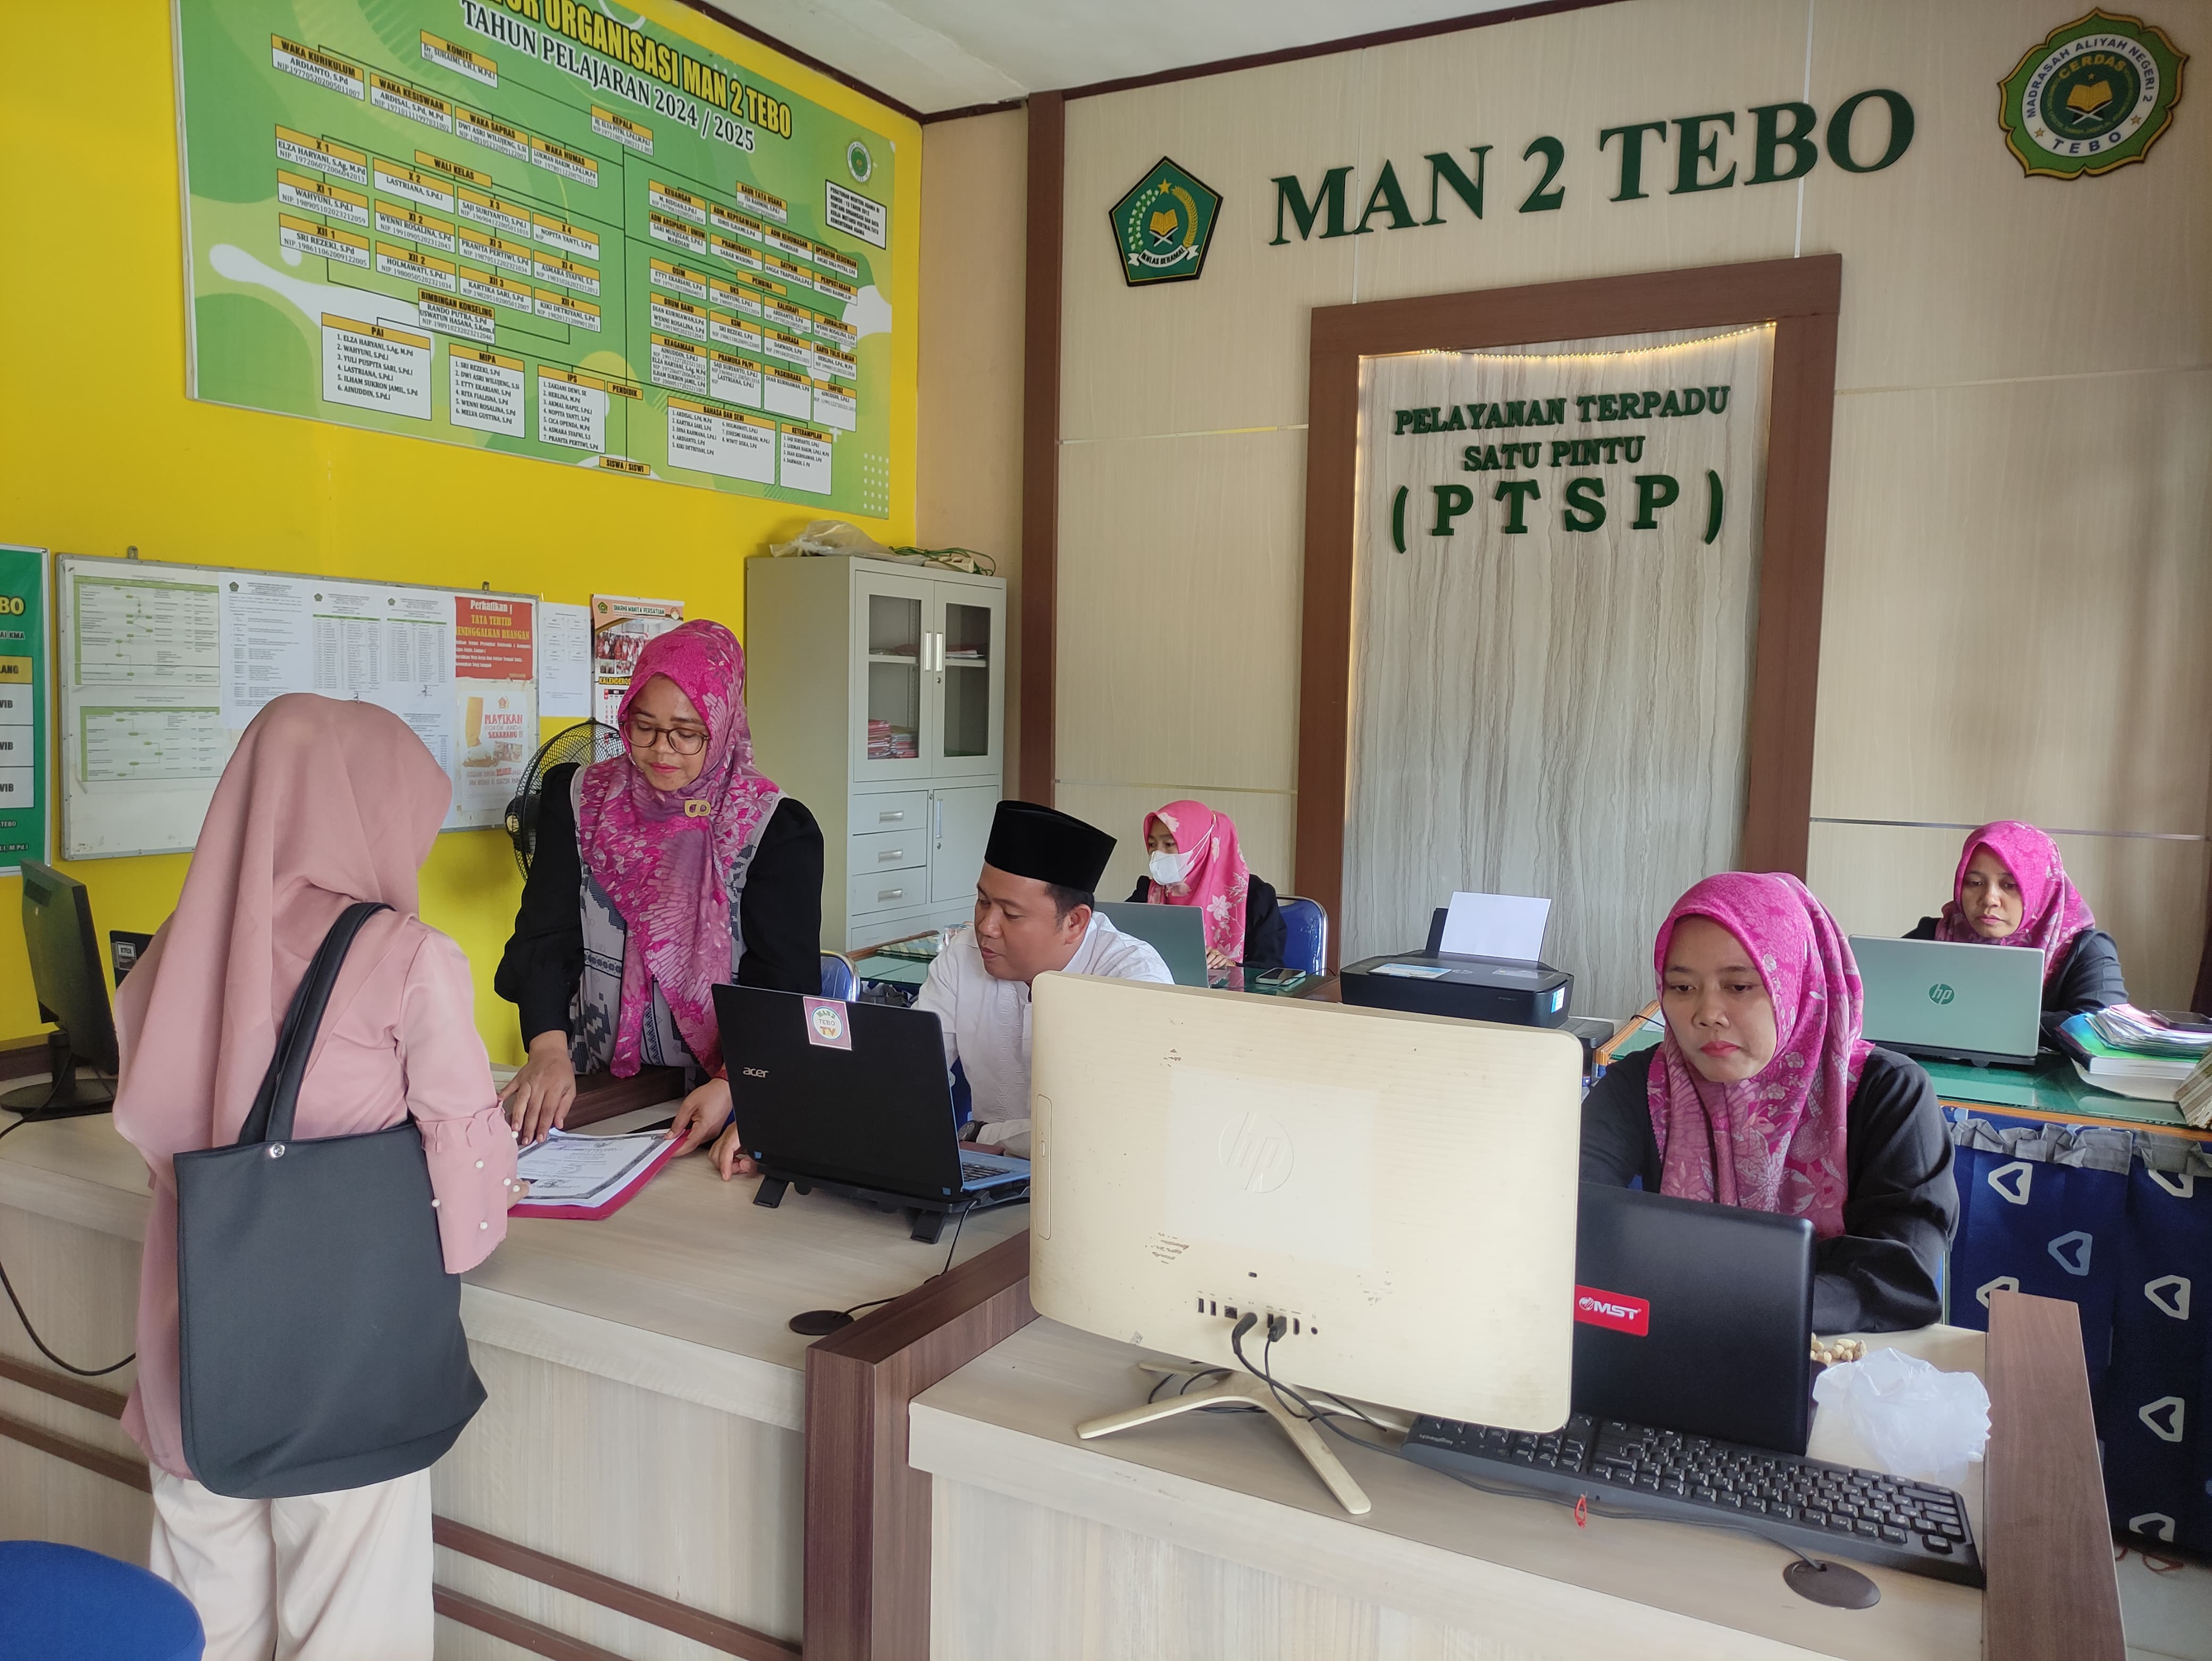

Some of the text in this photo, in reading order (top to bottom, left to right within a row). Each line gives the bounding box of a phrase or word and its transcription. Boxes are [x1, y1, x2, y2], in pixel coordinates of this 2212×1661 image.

[281, 40, 355, 77] WAKA KURIKULUM
[447, 43, 473, 62] KOMITE
[543, 0, 679, 88] ORGANISASI
[683, 54, 726, 110] MAN
[730, 77, 744, 118] 2
[745, 87, 792, 140] TEBO
[2059, 54, 2127, 79] CERDAS
[333, 73, 348, 85] S.Pd
[460, 0, 537, 54] TAHUN
[543, 36, 650, 107] PELAJARAN
[655, 88, 698, 127] 2024
[701, 110, 710, 136] /
[715, 116, 754, 152] 2025
[2027, 48, 2070, 119] MADRASAH
[2075, 38, 2128, 52] ALIYAH
[2128, 46, 2155, 91] NEGERI
[379, 78, 443, 111] WAKA KESISWAAN
[429, 110, 443, 121] M.Pd
[470, 114, 515, 139] WAKA SAPRAS
[613, 115, 633, 131] KEPALA
[316, 140, 329, 153] X 1
[2052, 131, 2122, 154] TEBO
[278, 141, 296, 153] ELZA
[349, 164, 365, 176] M.Pd
[545, 143, 585, 166] WAKA HUMAS
[434, 158, 474, 180] WALI KELAS
[1269, 89, 1915, 246] MAN 2 TEBO
[409, 172, 421, 183] X 2
[316, 182, 332, 196] XI 1
[664, 187, 691, 204] KEUANGAN
[462, 202, 474, 211] SAJI
[409, 212, 423, 224] XI 2
[316, 226, 335, 239] XII 1
[379, 213, 402, 228] WENNI
[438, 231, 451, 243] S.Pd
[296, 232, 309, 243] SRI
[340, 245, 355, 255] S.Pd
[722, 239, 752, 256] PRAMUBAKTI
[408, 252, 425, 265] XII 2
[1141, 247, 1186, 265] IKHLAS BERAMAL
[672, 266, 685, 277] OSIM
[781, 261, 798, 272] SATPAM
[468, 281, 495, 295] KARTIKA
[730, 286, 739, 295] UKS
[752, 277, 773, 290] PEMBINA
[421, 291, 492, 318] BIMBINGAN KONSELING
[428, 304, 450, 315] RANDO
[664, 298, 694, 313] DRUM BAND
[731, 319, 741, 328] KSM
[372, 327, 384, 337] PAI
[343, 335, 357, 344] ELZA
[664, 338, 694, 353] KEAGAMAAN
[777, 333, 799, 346] OLAHRAGA
[343, 355, 357, 364] YULI
[358, 359, 382, 369] PUSPITA
[480, 353, 496, 364] MIPA
[718, 353, 740, 365] PRAMUKA
[567, 374, 577, 383] IPS
[775, 369, 802, 382] PASKIBRAKA
[613, 385, 638, 397] PENDIDIK
[703, 406, 744, 422] BAHASA DAN SENI
[1395, 386, 1730, 435] PELAYANAN TERPADU
[792, 426, 822, 440] KETERAMPILAN
[1464, 435, 1645, 471] SATU PINTU
[607, 459, 624, 470] SISWA
[629, 463, 644, 473] SISWI
[471, 600, 507, 612] Perhatikan
[471, 614, 512, 626] TATA TERTIB
[502, 629, 530, 640] RUANGAN
[0, 665, 19, 674] ANG
[484, 714, 523, 724] MATIKAN
[1932, 984, 1953, 1004] hp
[820, 1026, 836, 1036] TV
[743, 1067, 769, 1078] acer
[1226, 1111, 1289, 1191] hp
[1594, 1301, 1638, 1320] MST
